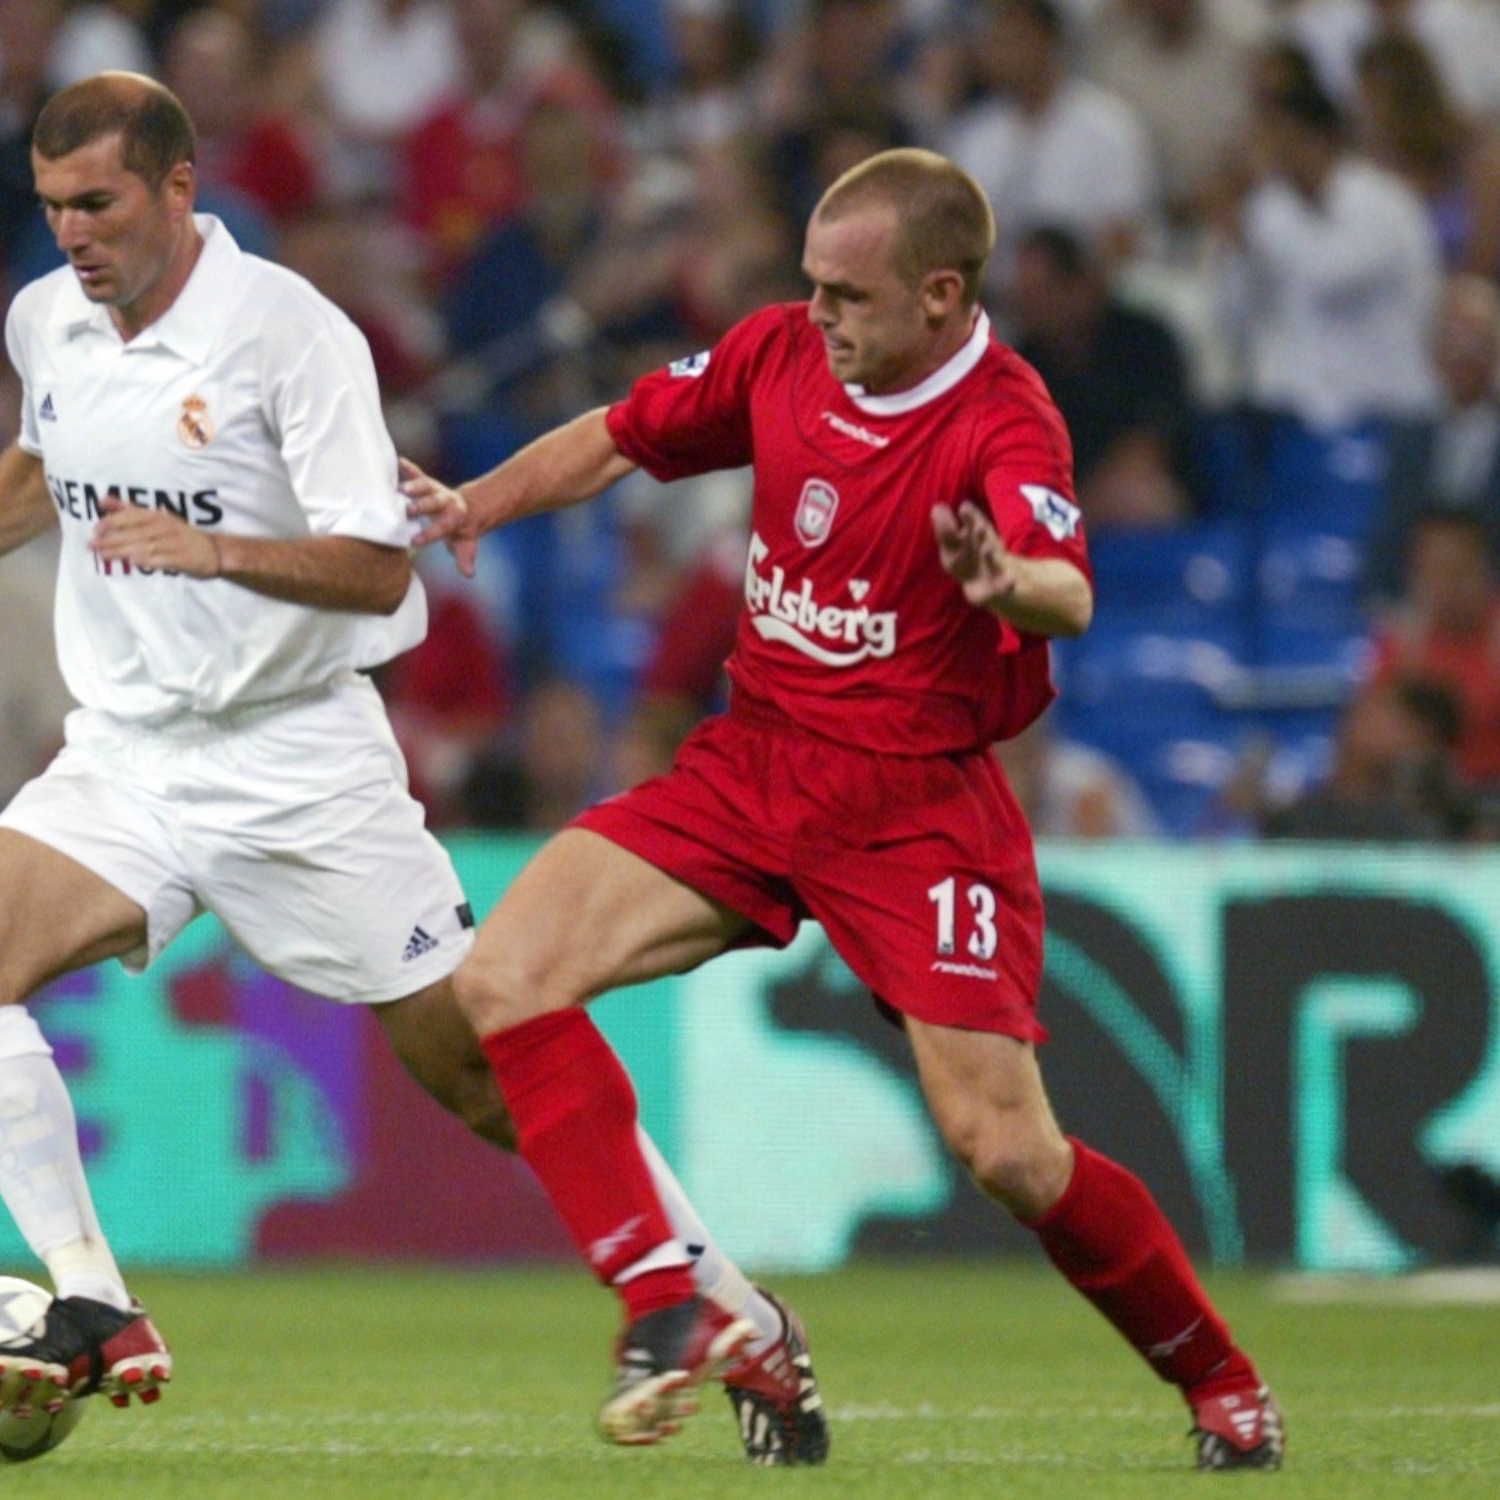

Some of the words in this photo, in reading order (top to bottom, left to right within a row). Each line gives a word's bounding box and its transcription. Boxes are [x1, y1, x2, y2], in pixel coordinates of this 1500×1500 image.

[48, 475, 224, 526] IEMENS
[745, 531, 897, 660] Crlsberg
[927, 875, 998, 960] 13
